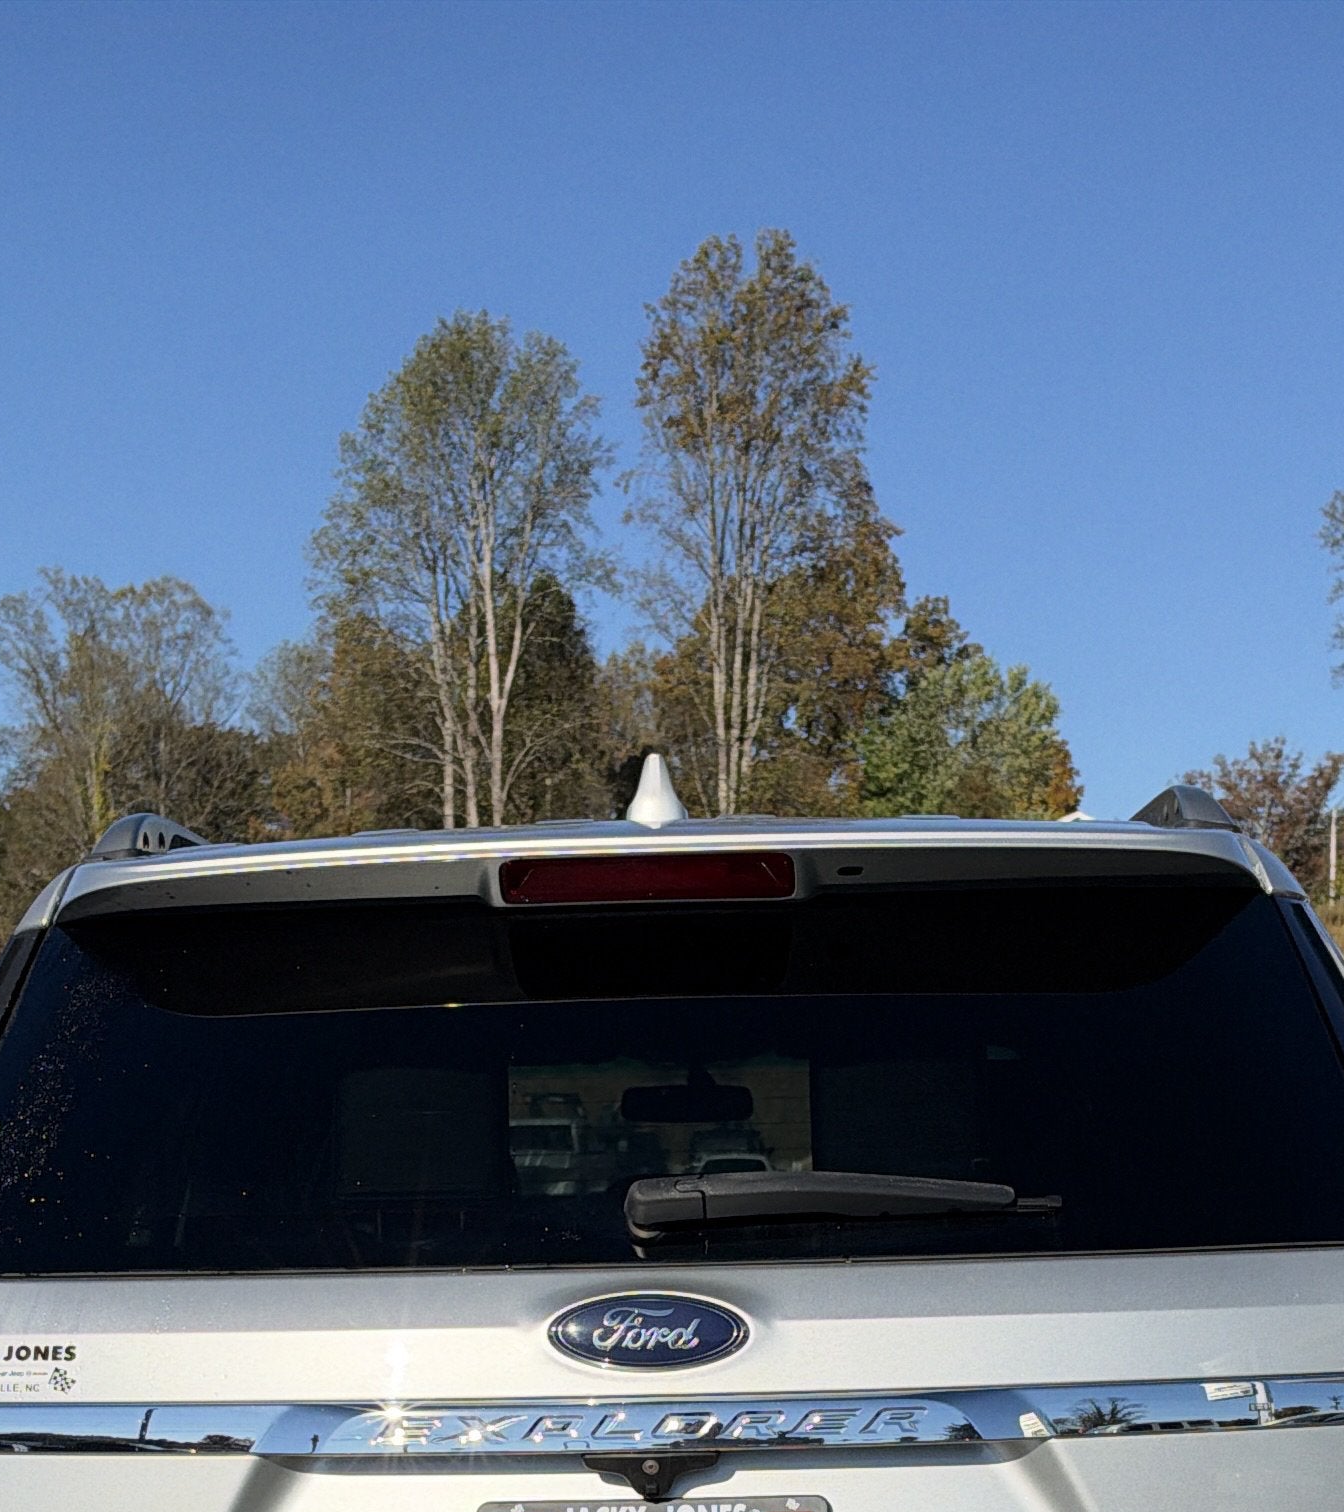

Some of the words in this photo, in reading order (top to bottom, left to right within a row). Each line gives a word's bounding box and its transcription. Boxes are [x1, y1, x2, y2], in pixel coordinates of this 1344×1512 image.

[593, 1307, 701, 1352] Ford
[3, 1345, 77, 1361] JONES
[25, 1383, 40, 1392] NC
[374, 1406, 929, 1444] EXPLORER
